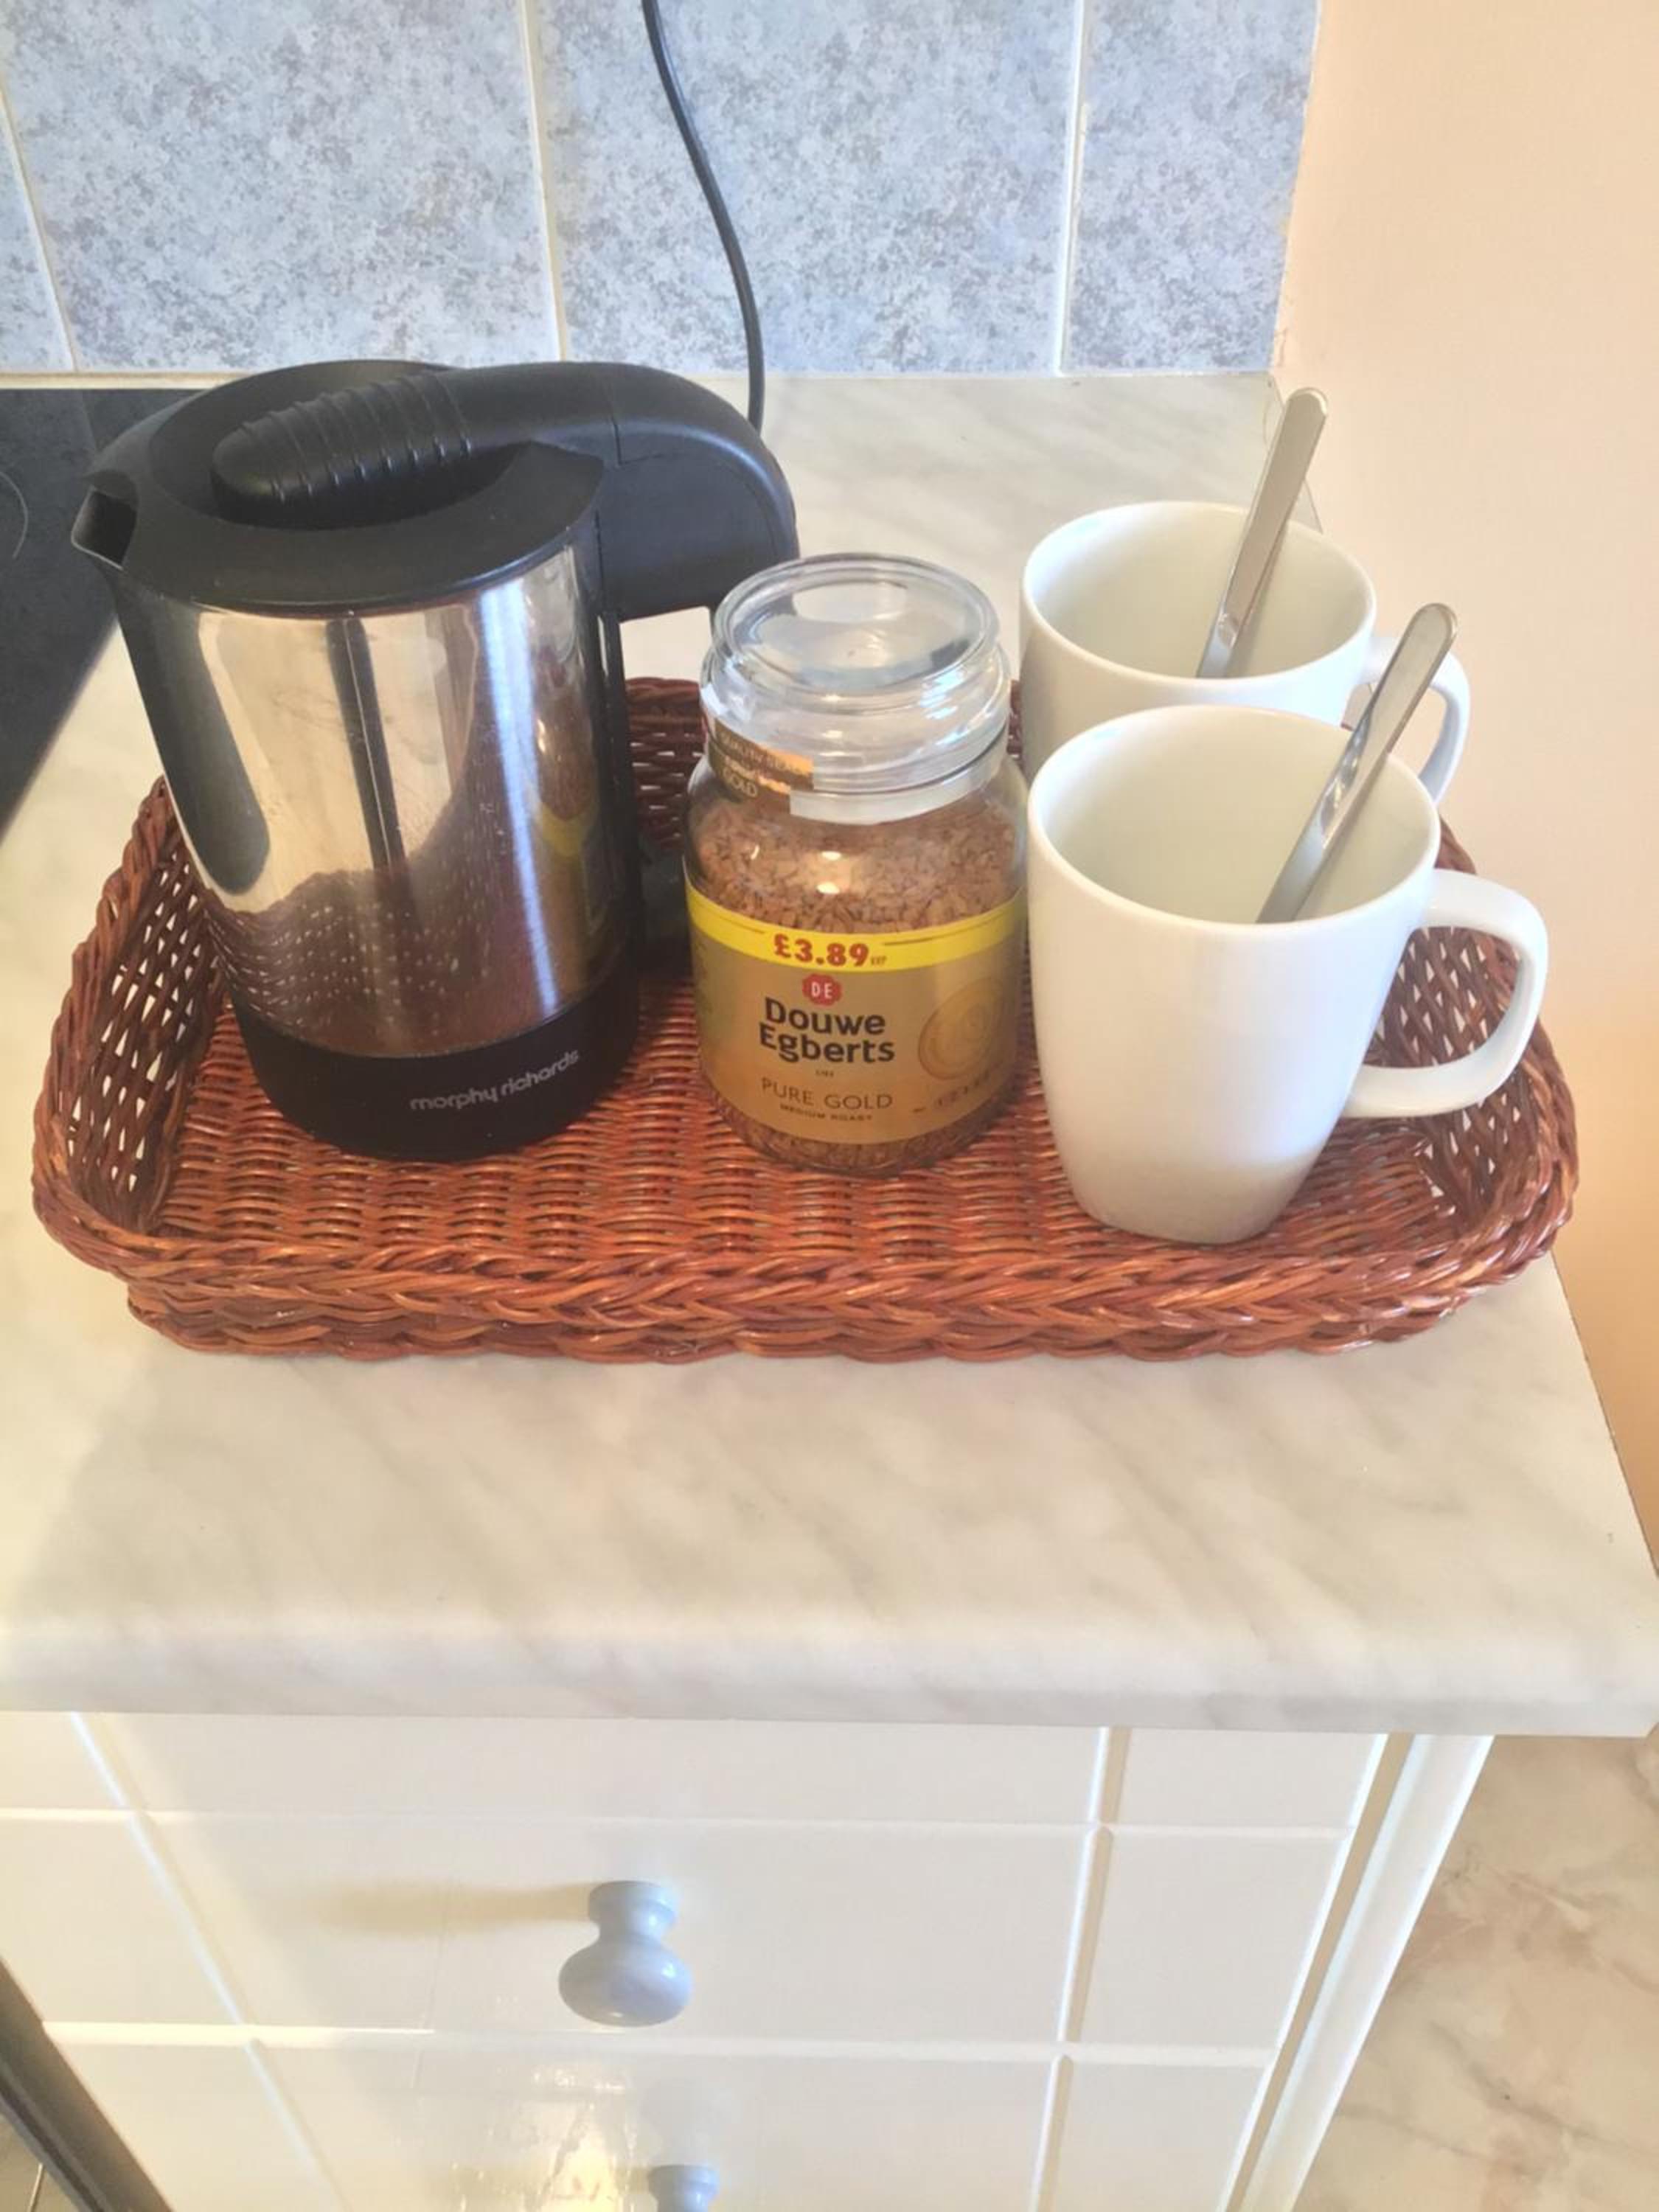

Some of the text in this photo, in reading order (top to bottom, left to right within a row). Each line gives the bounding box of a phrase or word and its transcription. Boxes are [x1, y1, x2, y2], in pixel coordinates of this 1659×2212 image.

[774, 933, 869, 967] £3.89
[811, 981, 833, 999] DE
[765, 997, 886, 1035] Douwe
[759, 1023, 895, 1062] Egberts
[410, 1050, 579, 1110] morphy richards
[762, 1077, 893, 1109] PURE GOLD
